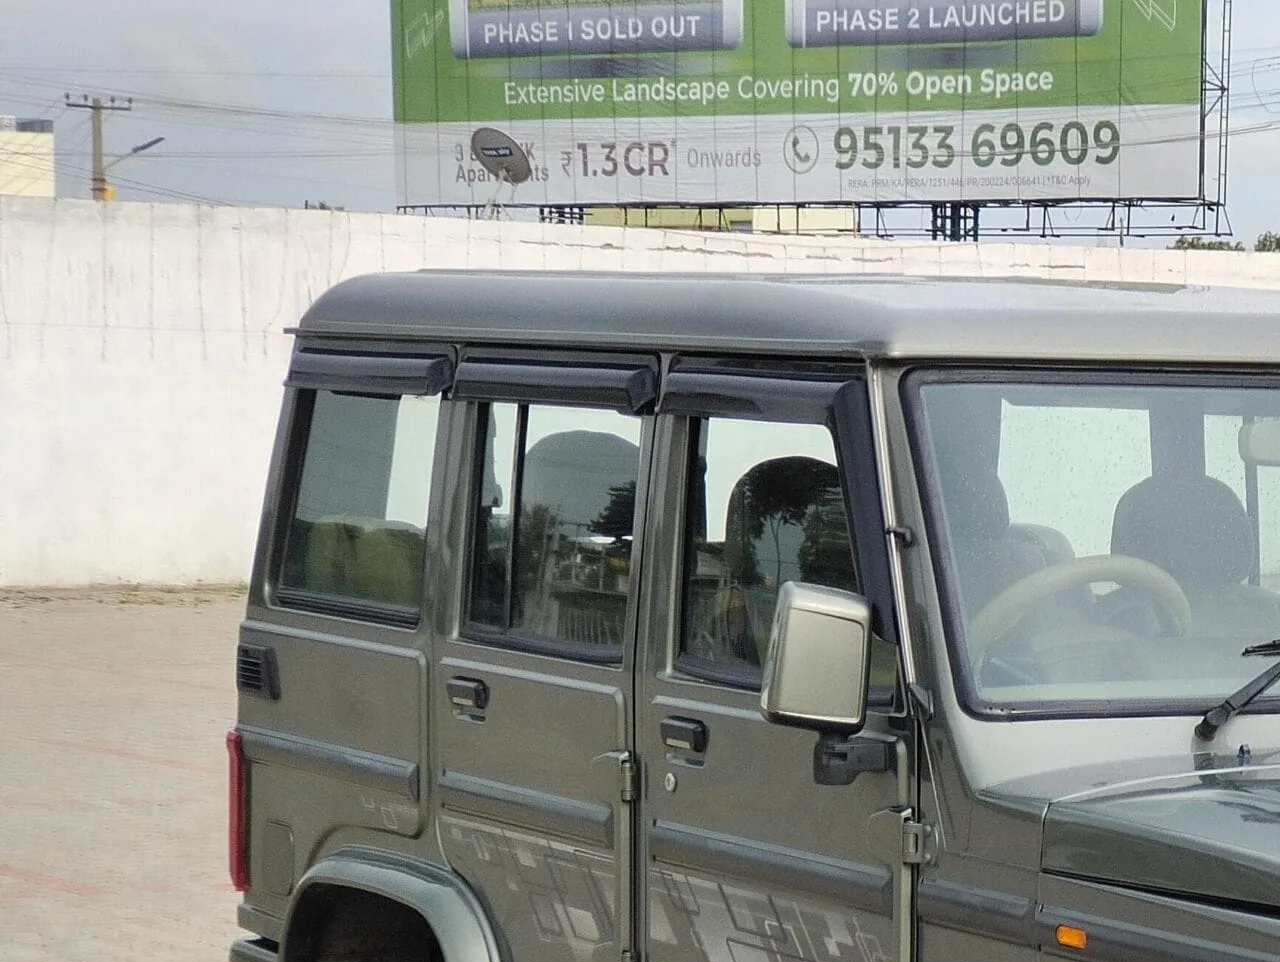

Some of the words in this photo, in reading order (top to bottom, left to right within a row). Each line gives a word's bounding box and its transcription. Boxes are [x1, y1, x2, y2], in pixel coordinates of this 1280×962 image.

[484, 21, 558, 44] PHASE
[580, 16, 643, 41] SOLD
[651, 15, 700, 39] OUT
[816, 8, 899, 32] PHASE
[907, 8, 920, 29] 2
[929, 0, 1065, 28] LAUNCHED
[504, 78, 605, 105] Extensive
[612, 76, 730, 106] Landscape
[737, 73, 840, 102] Covering
[848, 72, 898, 97] 70%
[906, 70, 972, 100] Open
[980, 68, 1054, 98] Space
[687, 147, 762, 169] Onwards
[833, 125, 955, 170] 95133
[971, 120, 1120, 168] 69609
